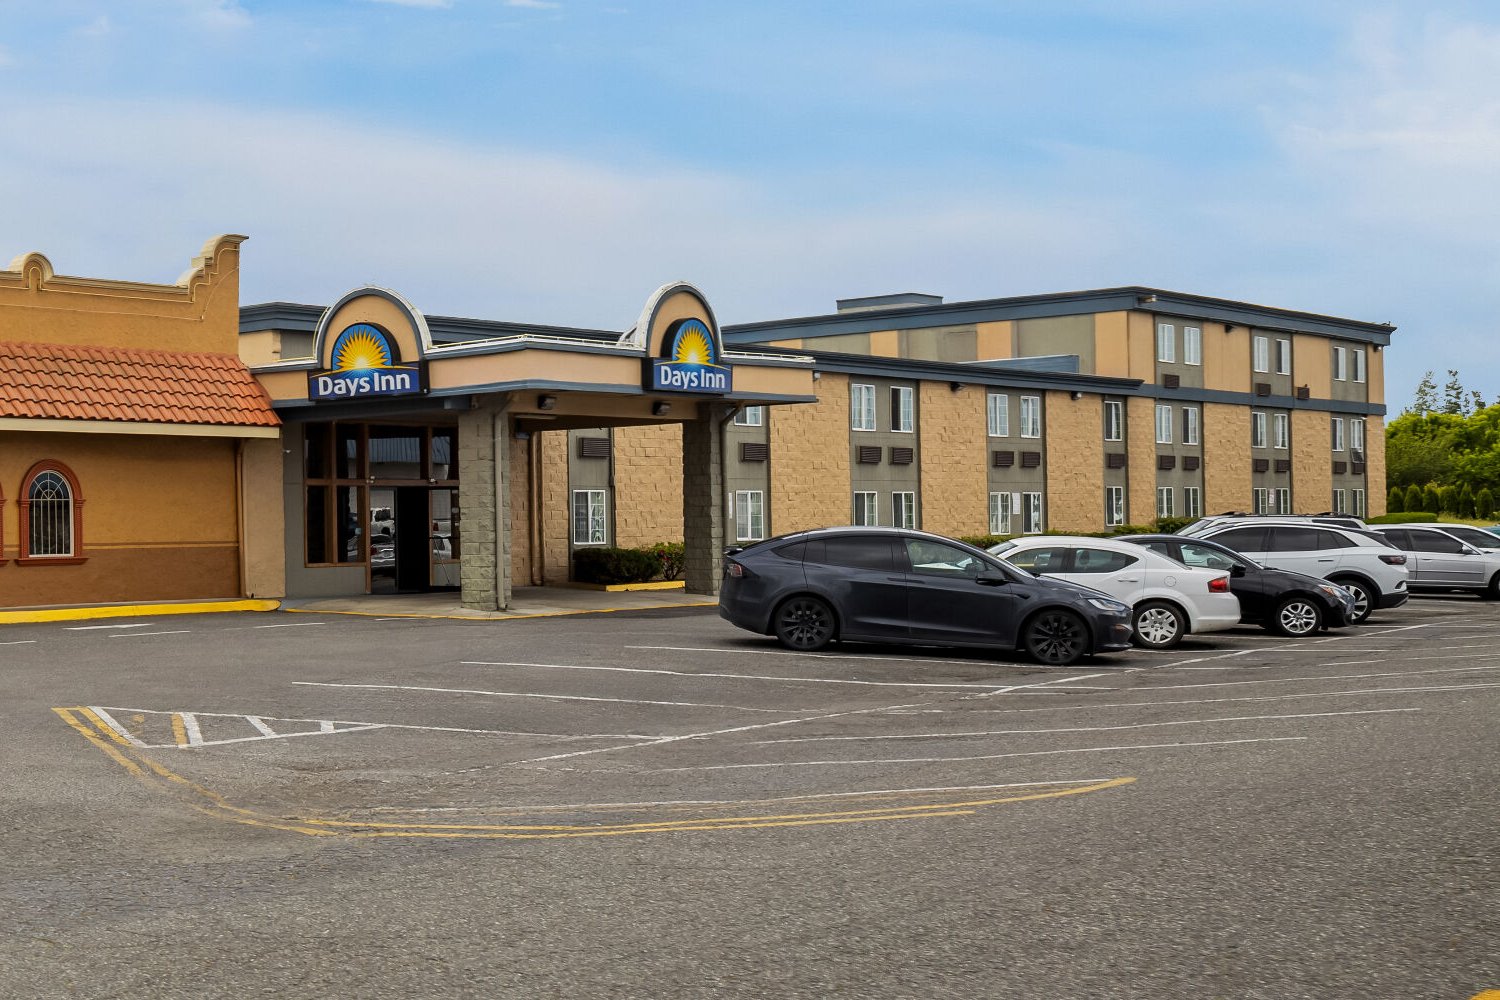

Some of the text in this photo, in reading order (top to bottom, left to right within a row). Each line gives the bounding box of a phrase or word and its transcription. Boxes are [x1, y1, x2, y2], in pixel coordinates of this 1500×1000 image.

[318, 372, 411, 397] Days Inn
[661, 365, 725, 390] Days Inn
